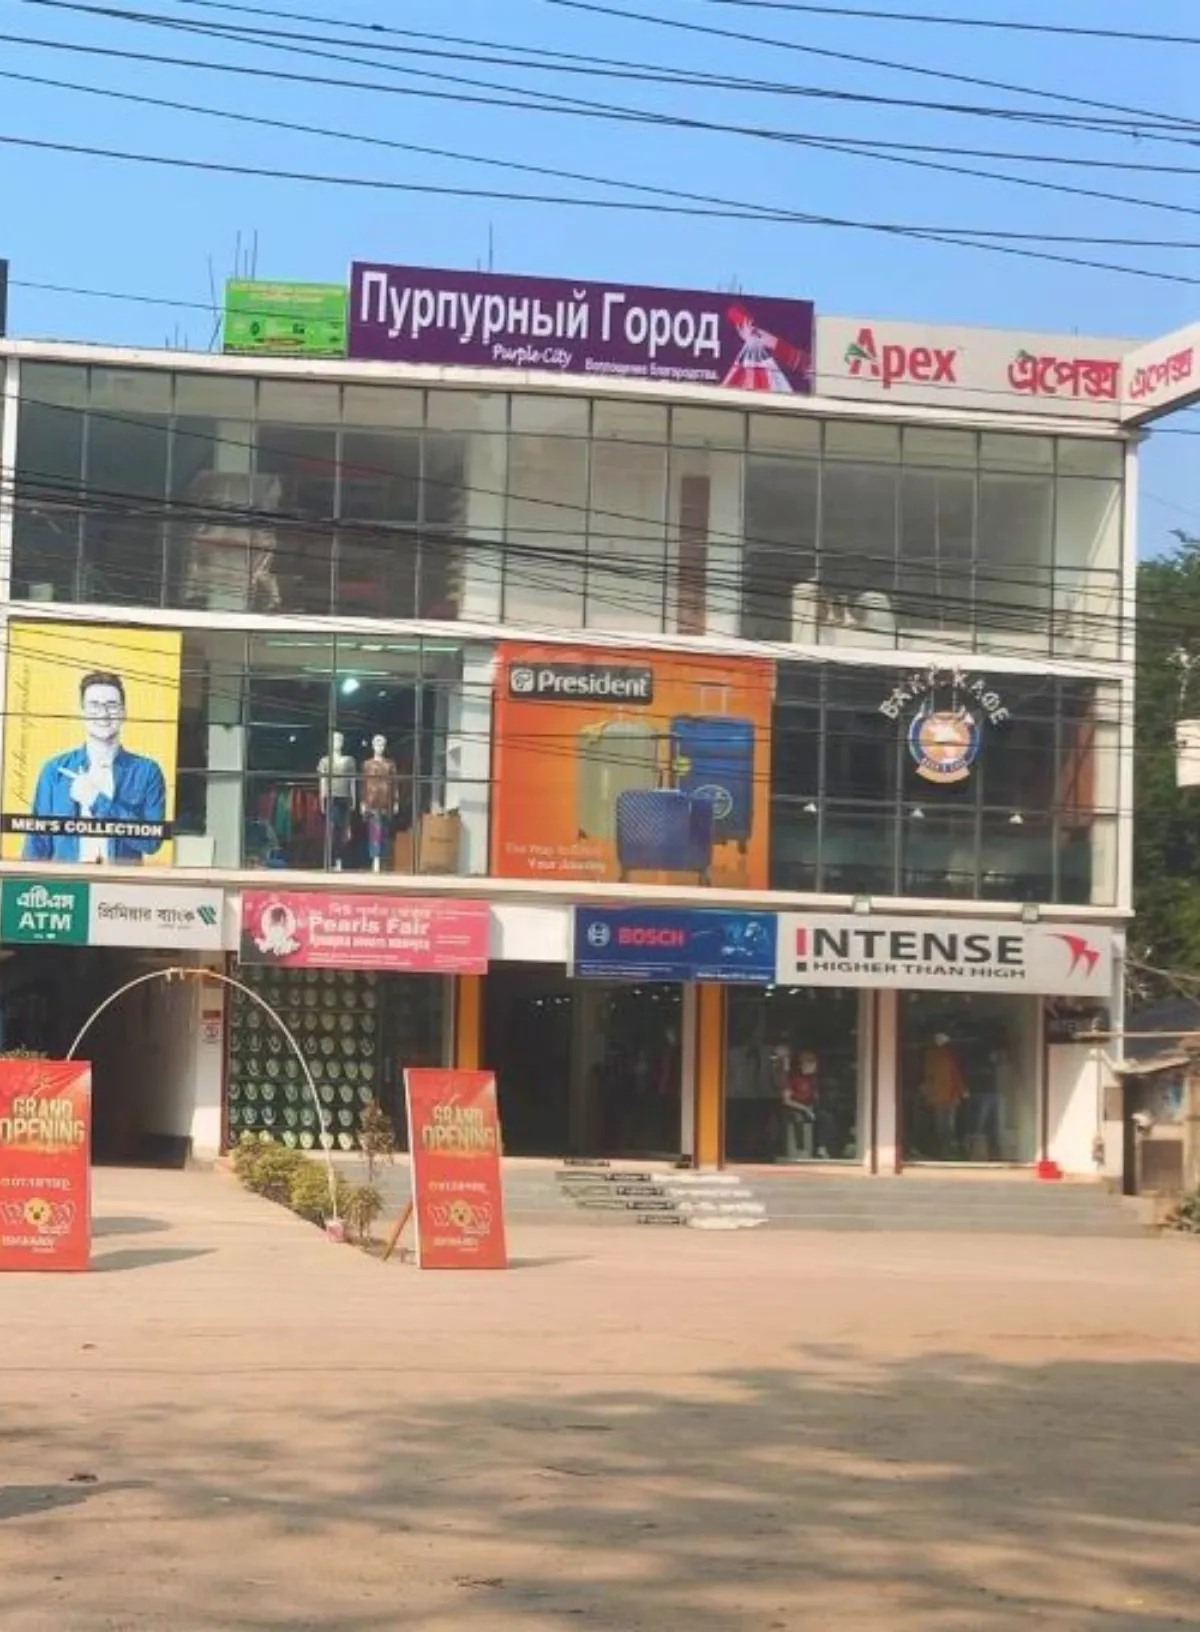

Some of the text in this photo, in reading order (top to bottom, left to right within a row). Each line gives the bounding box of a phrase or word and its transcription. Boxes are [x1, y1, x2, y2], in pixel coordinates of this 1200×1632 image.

[360, 271, 721, 358] Пурпурный Город
[844, 328, 958, 388] Apex
[1007, 350, 1121, 399] এপেক্স
[538, 669, 649, 697] President
[11, 818, 164, 837] MEN'S COLLECTION
[16, 885, 75, 909] এটিএম
[18, 911, 72, 932] ATM
[309, 912, 431, 936] Pearls Fair
[618, 927, 684, 947] BOSCH
[796, 927, 1025, 965] INTENSE
[813, 961, 1026, 979] HIGHER THAN HIGH
[13, 1096, 74, 1119] GRAND
